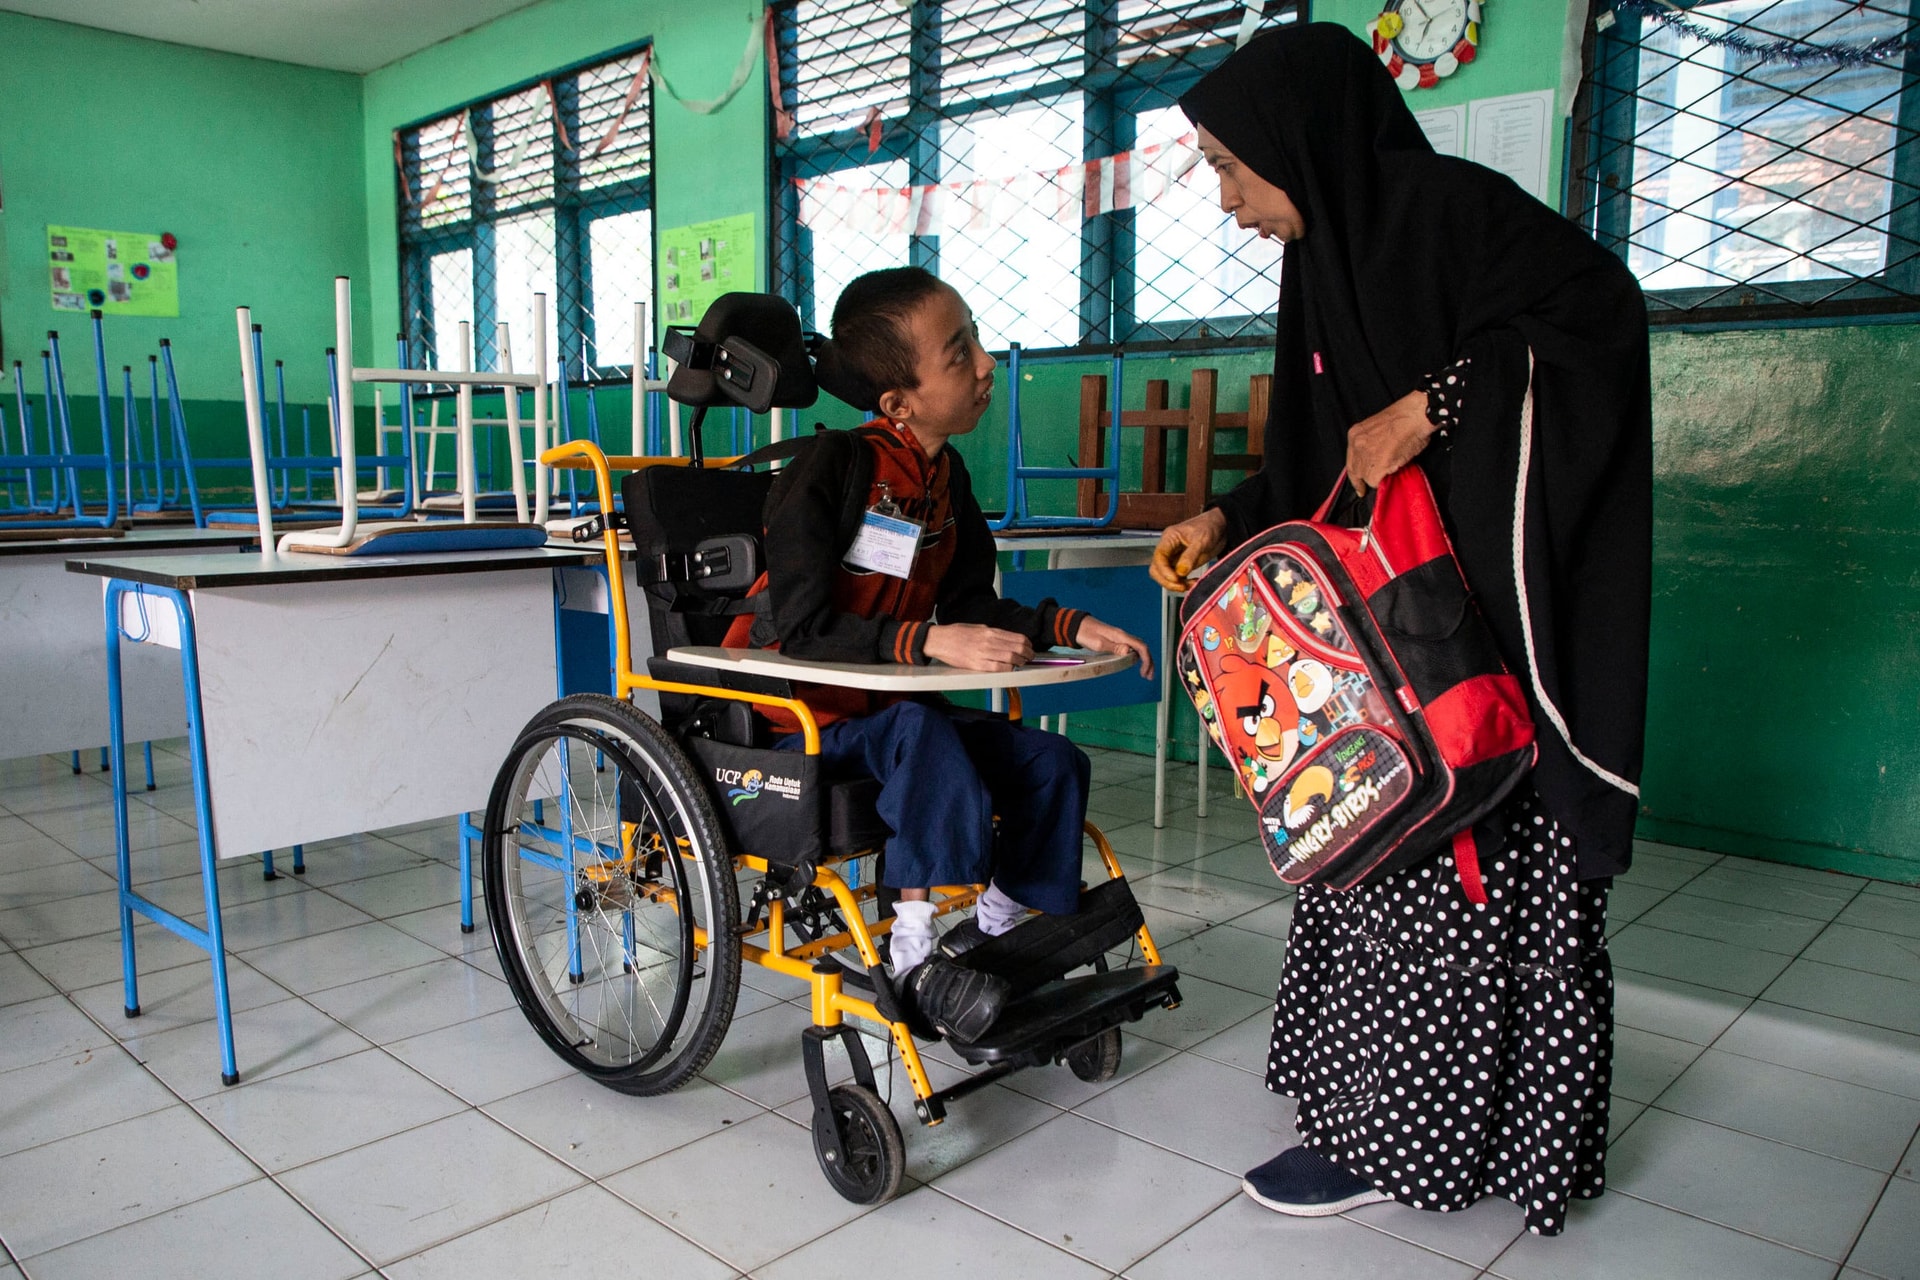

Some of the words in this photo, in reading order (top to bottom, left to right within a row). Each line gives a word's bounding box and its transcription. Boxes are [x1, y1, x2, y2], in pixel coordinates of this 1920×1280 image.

[1404, 7, 1412, 16] 10
[1456, 9, 1461, 18] 3
[1451, 24, 1457, 33] 4
[1404, 36, 1410, 45] 8
[1442, 37, 1447, 46] 5
[1415, 43, 1421, 52] 7
[1428, 45, 1434, 53] 6
[716, 767, 742, 785] UCP
[1289, 814, 1334, 863] ANGRY
[1331, 776, 1380, 829] BIRDS
